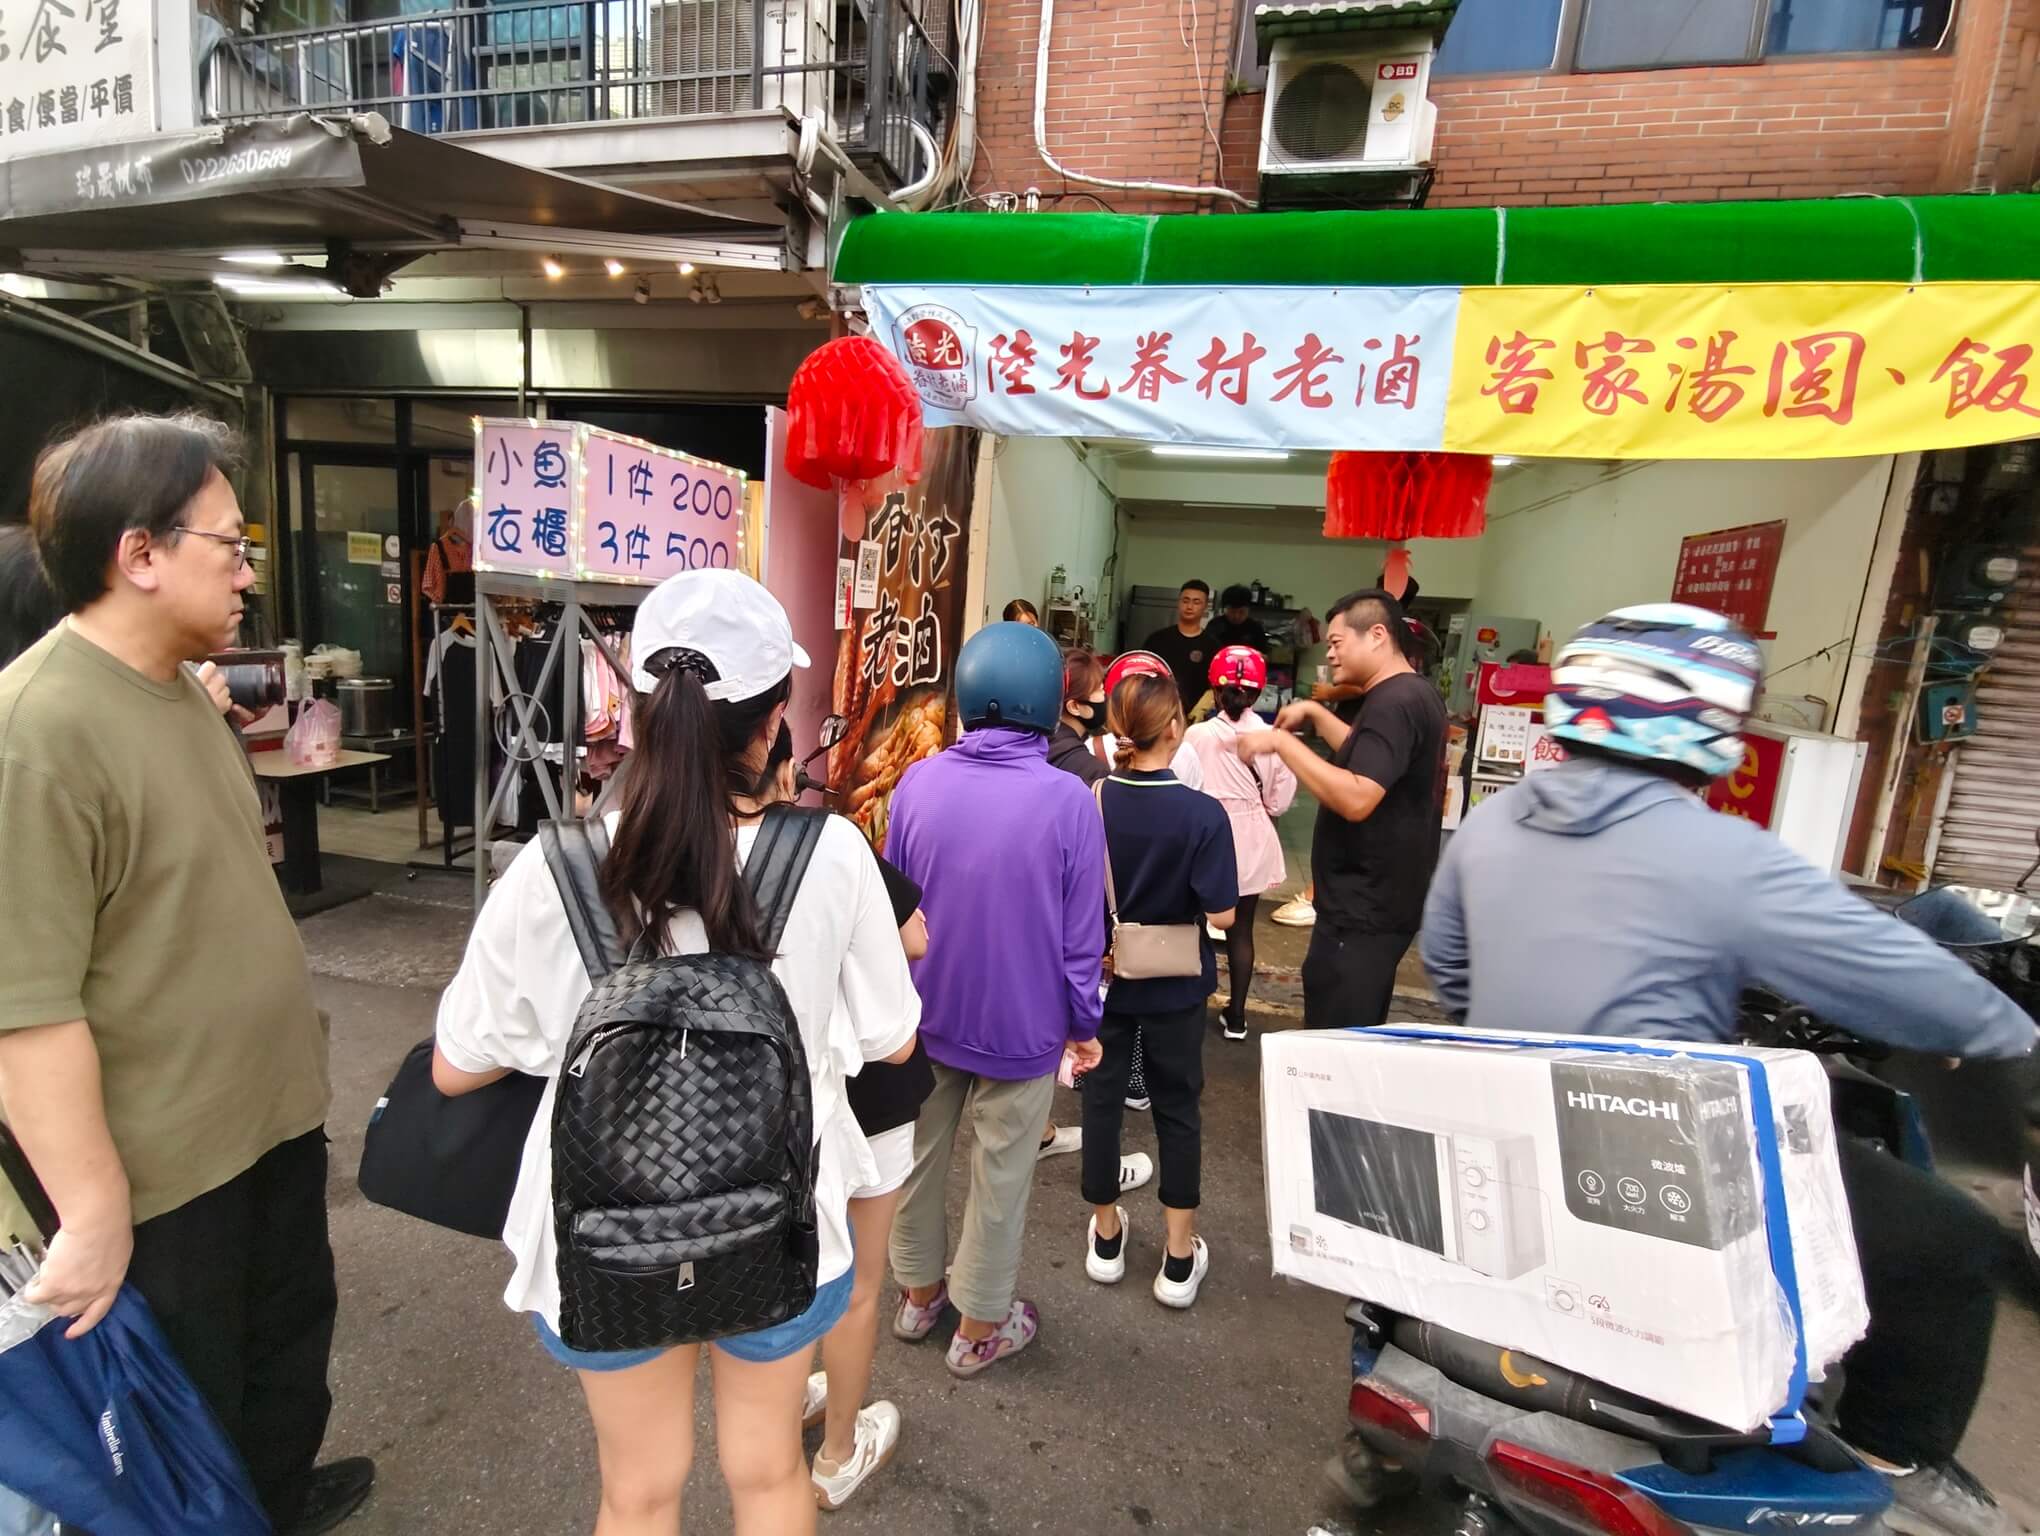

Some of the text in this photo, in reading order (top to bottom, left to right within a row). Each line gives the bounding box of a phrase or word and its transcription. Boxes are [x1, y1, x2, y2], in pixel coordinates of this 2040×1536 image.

[0, 0, 122, 63] 食堂
[0, 74, 134, 136] 食/便當/平價
[987, 329, 1420, 410] 陸光眷村老滷
[488, 438, 567, 489] 小魚
[608, 454, 732, 520] 1件 200
[487, 504, 567, 557] 衣櫃
[598, 521, 729, 573] 3件 500
[1286, 1066, 1297, 1077] 20
[1567, 1090, 1680, 1121] HITACHI
[101, 1410, 121, 1453] Umbrella
